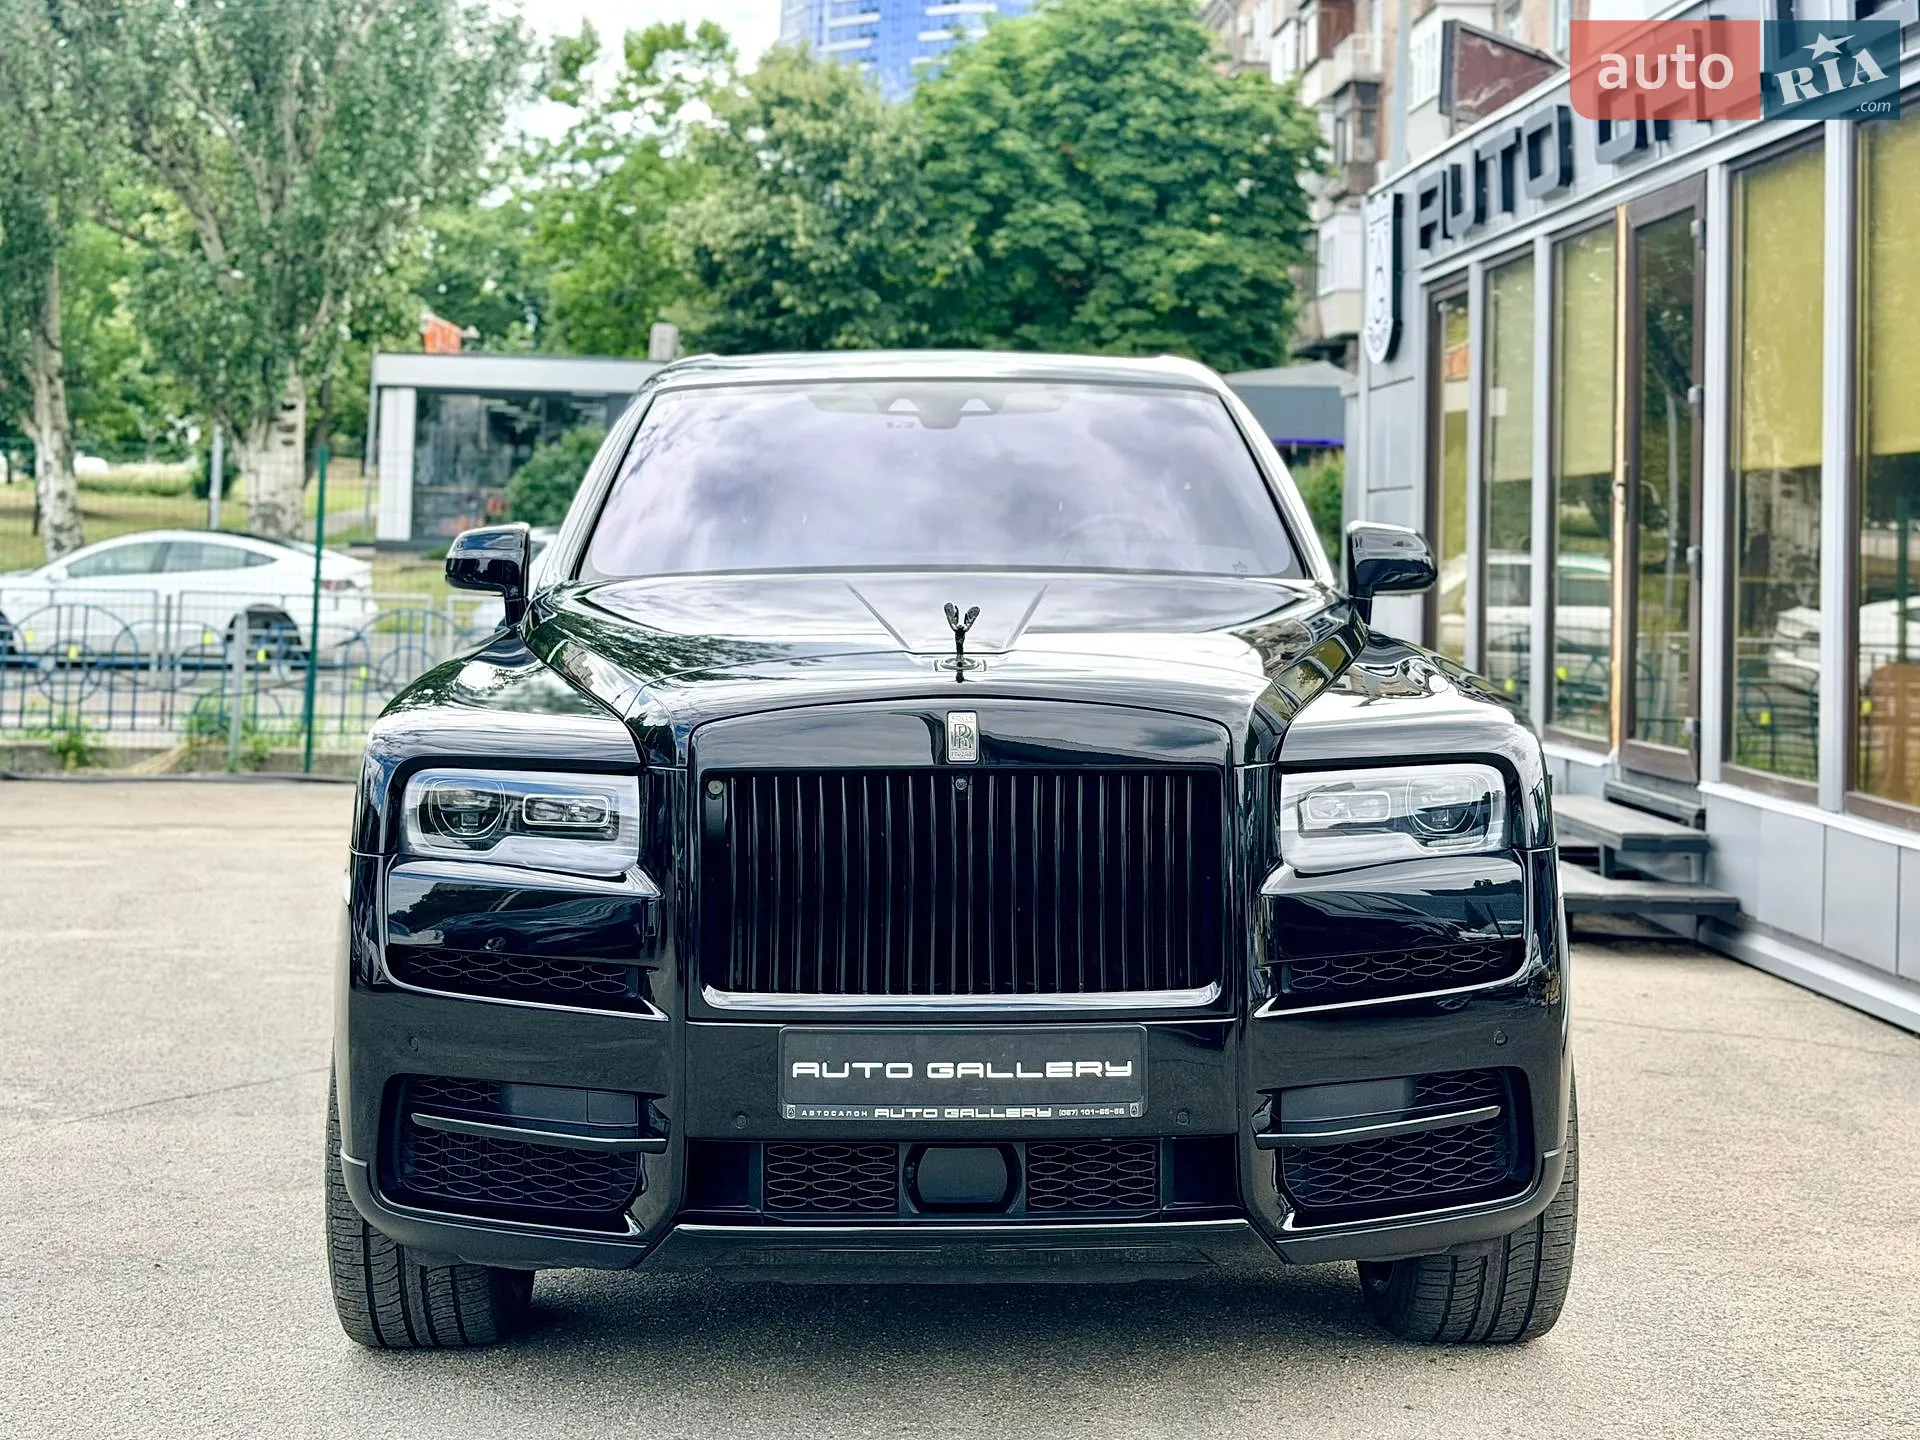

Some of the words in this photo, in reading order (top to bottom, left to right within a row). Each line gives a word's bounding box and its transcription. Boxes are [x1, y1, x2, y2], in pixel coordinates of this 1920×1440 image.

[1416, 104, 1574, 250] AUTO
[792, 1062, 913, 1078] AUTO
[927, 1061, 1132, 1078] GALLERY
[874, 1108, 938, 1118] AUTO
[944, 1107, 1052, 1118] GALLERY
